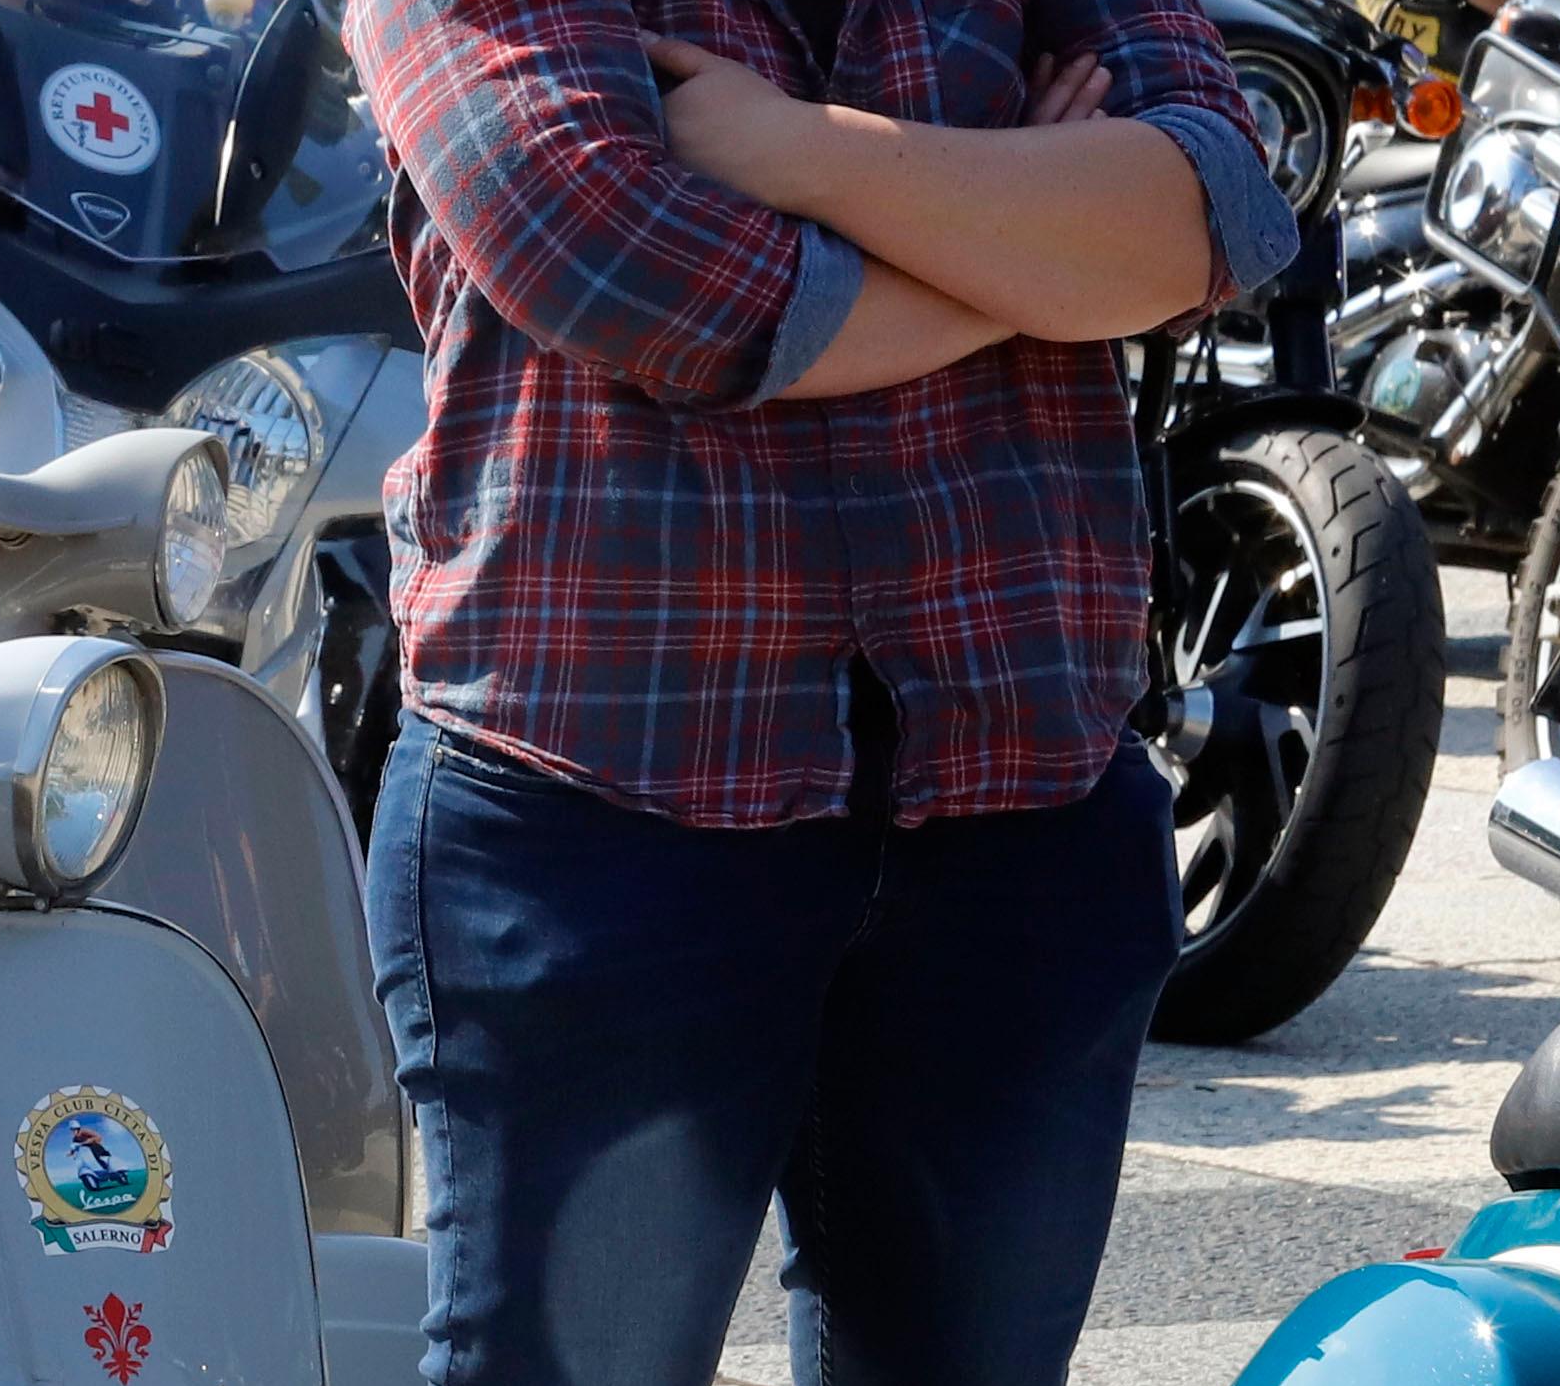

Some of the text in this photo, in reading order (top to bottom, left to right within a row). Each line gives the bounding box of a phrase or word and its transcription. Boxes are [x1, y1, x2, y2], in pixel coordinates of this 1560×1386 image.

[51, 71, 152, 146] RETTUNGSDIENST
[31, 1123, 51, 1171] VESPA
[54, 1099, 95, 1119] CLUB
[148, 1153, 160, 1172] DI
[80, 1190, 136, 1211] Vespa
[73, 1229, 141, 1245] SALERNO
